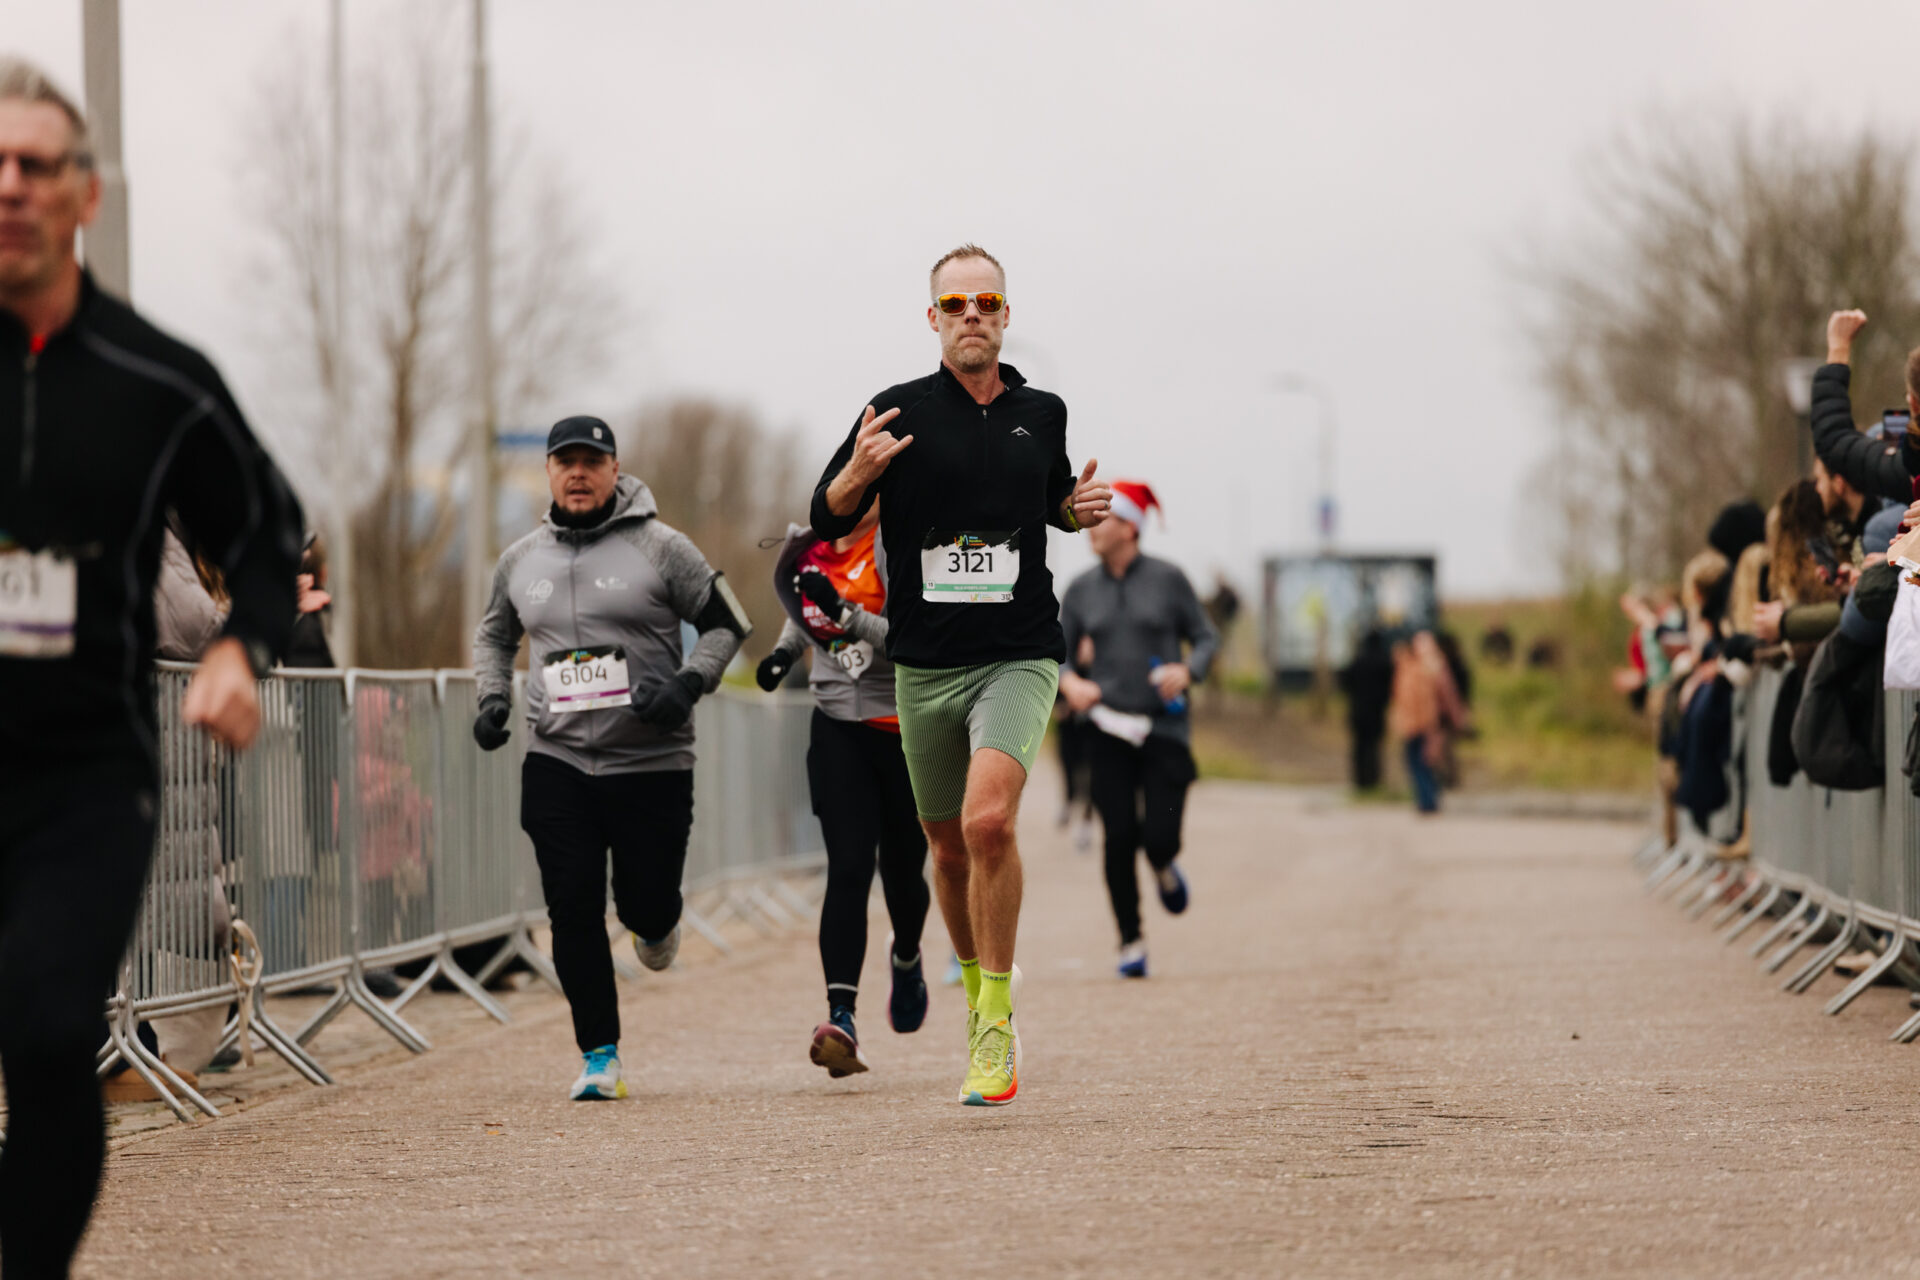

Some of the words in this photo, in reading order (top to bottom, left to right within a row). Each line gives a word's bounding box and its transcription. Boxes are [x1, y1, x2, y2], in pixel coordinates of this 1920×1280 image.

[948, 552, 993, 573] 3121
[841, 649, 865, 671] 03
[560, 664, 608, 686] 6104
